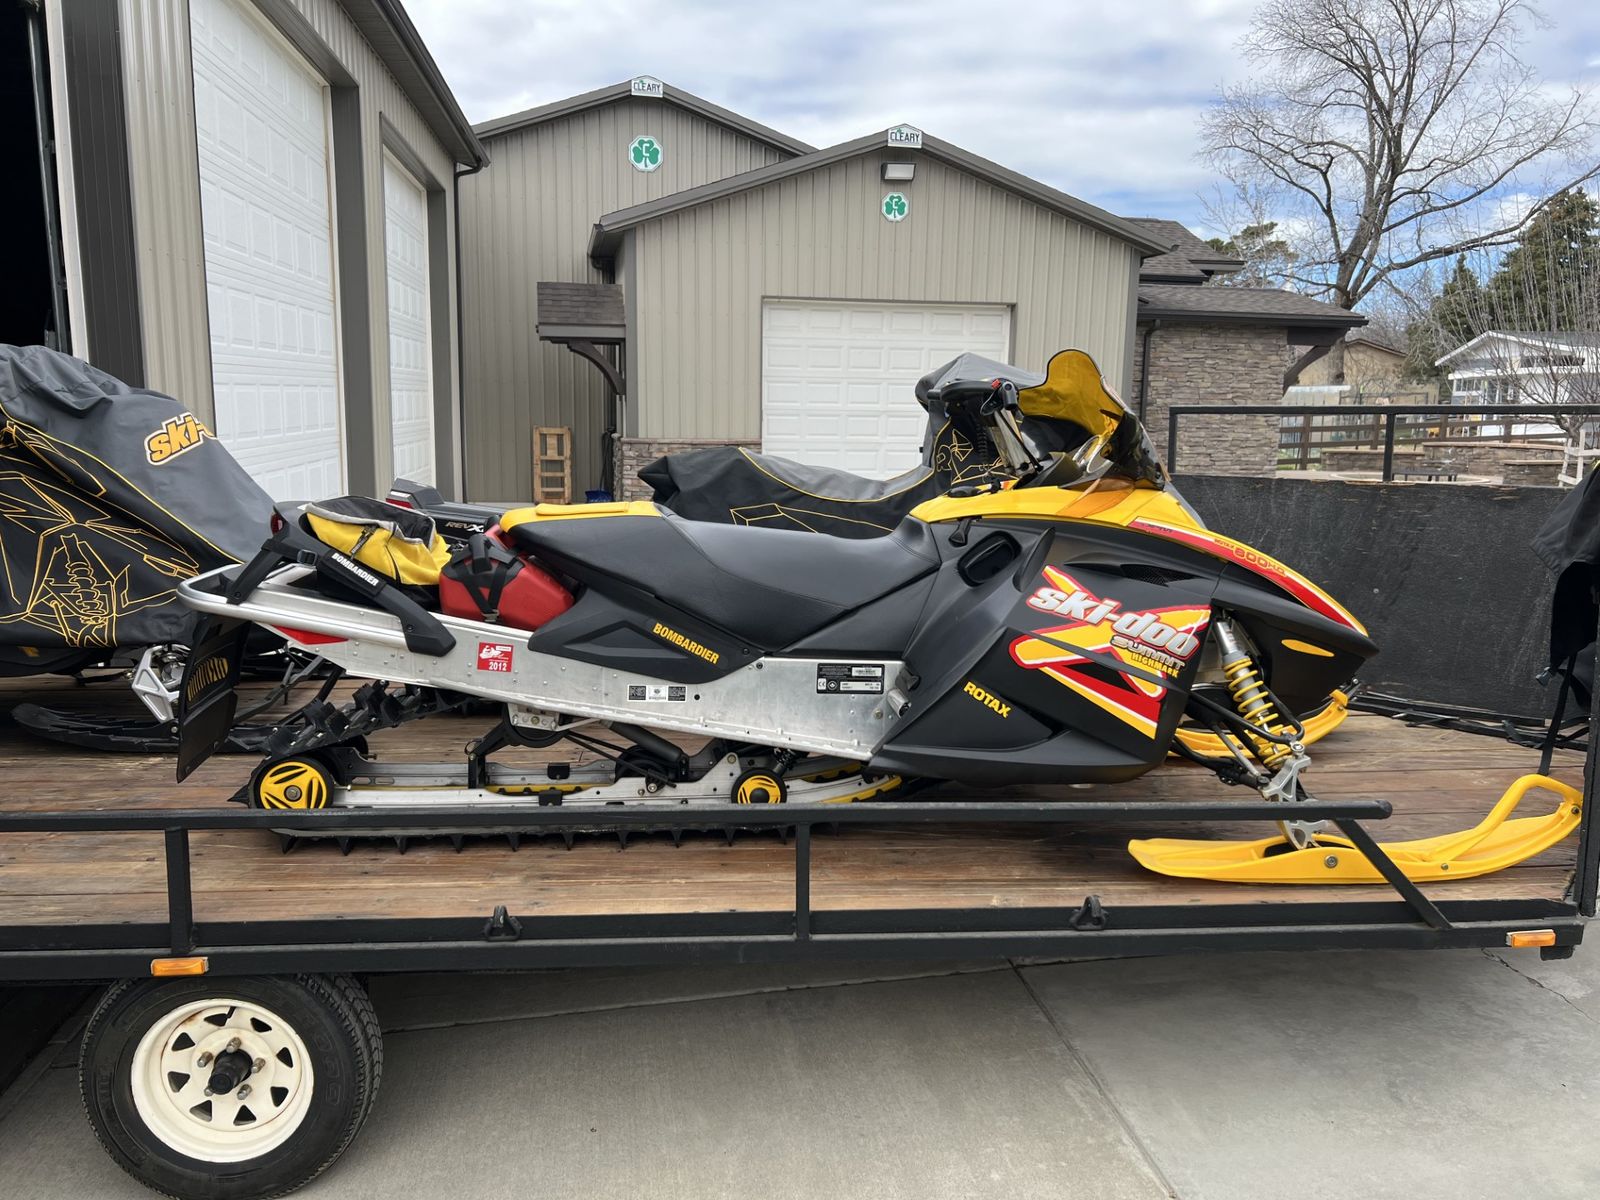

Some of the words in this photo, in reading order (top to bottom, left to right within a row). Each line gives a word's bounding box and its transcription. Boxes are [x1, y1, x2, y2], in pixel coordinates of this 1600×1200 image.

[633, 82, 661, 92] CLEARY
[890, 131, 920, 142] CLEARY
[445, 521, 484, 533] REVX
[331, 552, 380, 587] BOMBARDIER
[652, 622, 720, 665] BOMBARDIER
[1110, 635, 1187, 671] SUMMIT
[488, 661, 508, 671] 2012
[1131, 652, 1180, 679] HIGHMARK
[963, 681, 1011, 718] ROTAX
